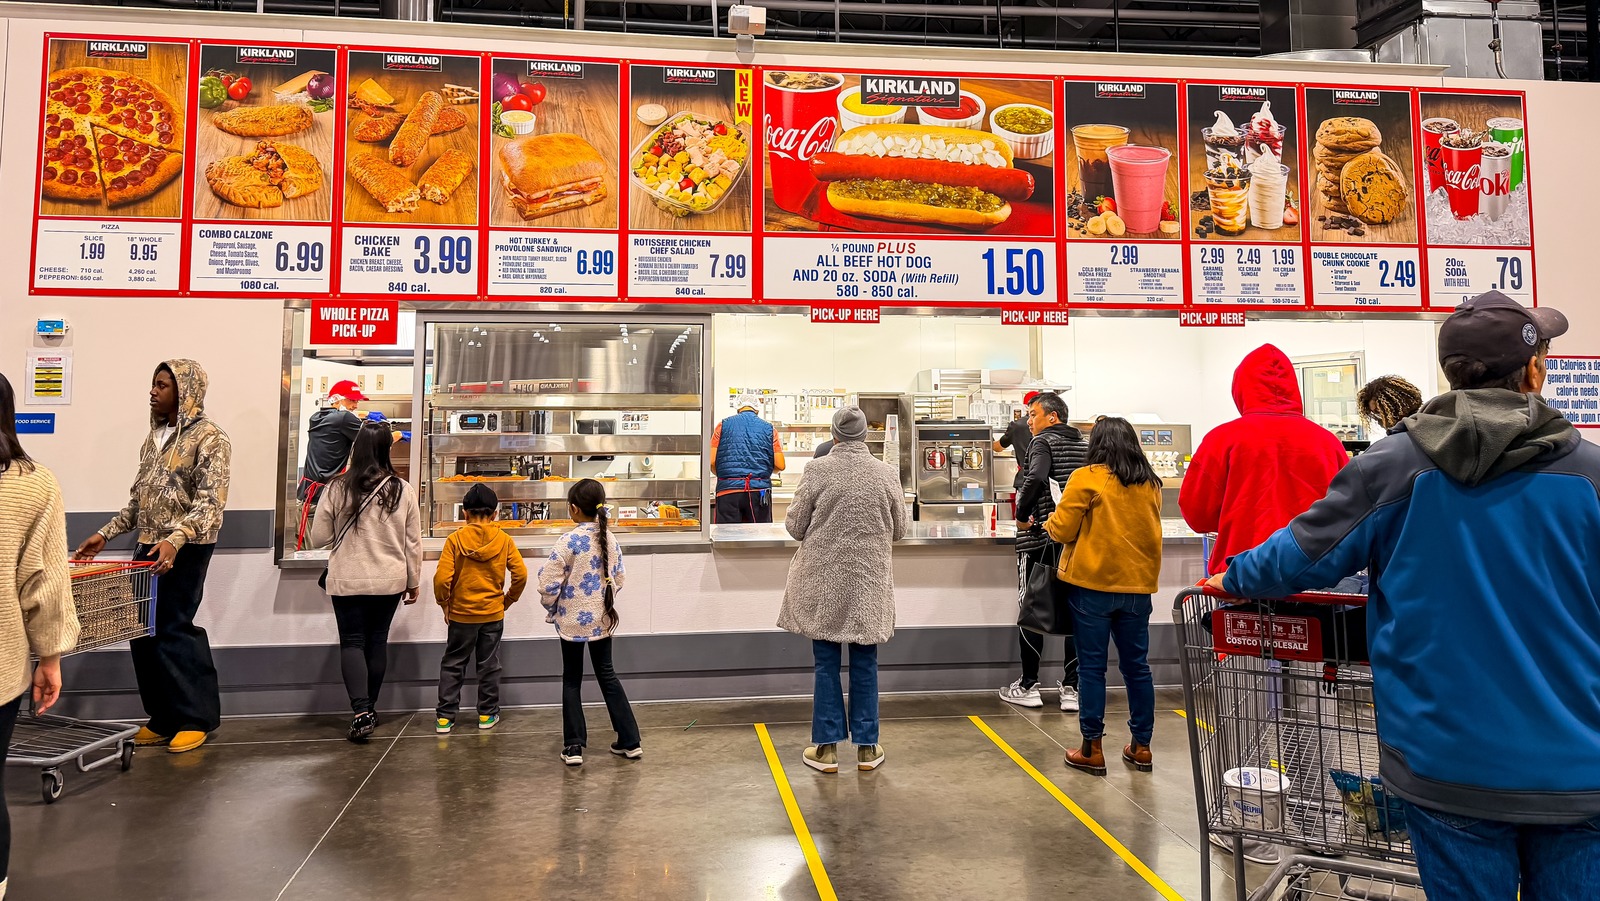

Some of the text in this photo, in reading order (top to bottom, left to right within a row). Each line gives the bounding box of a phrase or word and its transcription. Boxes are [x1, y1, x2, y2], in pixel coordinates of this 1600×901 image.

[90, 42, 146, 53] KIRKLAND
[240, 48, 294, 59] KIRKLAND
[387, 55, 439, 65] KIRKLAND
[531, 62, 581, 72] KIRKLAND
[666, 69, 715, 78] KIRKLAND
[866, 78, 955, 94] KIRKLAND
[1098, 84, 1143, 93] KIRKLAND
[1221, 87, 1265, 96] KIRKLAND
[738, 73, 752, 116] NEW
[867, 93, 955, 105] Signature
[1335, 91, 1378, 99] KIRKLAND
[199, 230, 273, 239] COMBO CALZONE
[355, 235, 400, 246] CHICKEN
[679, 239, 711, 247] CHICKEN
[80, 243, 105, 259] 1.99
[130, 244, 157, 261] 9.95
[363, 247, 391, 256] BAKE
[671, 247, 695, 255] SALAD
[842, 244, 874, 253] POUND
[877, 242, 916, 254] PLUS
[276, 241, 324, 272] 6.99
[414, 236, 472, 274] 3.99
[1111, 245, 1138, 265] 2.99
[1201, 248, 1225, 264] 2.99
[1237, 248, 1261, 265] 2.49
[1272, 249, 1294, 265] 1.99
[577, 250, 614, 275] 6.99
[710, 254, 746, 278] 7.99
[817, 255, 931, 268] ALL BEEF HOT DOG
[1446, 258, 1456, 266] 20
[982, 248, 1045, 295] 1.50
[1379, 260, 1415, 287] 2.49
[1445, 268, 1467, 276] SODA
[1492, 257, 1522, 289] .79
[793, 269, 959, 286] AND 20 oz. SODA (With Refill)
[1444, 278, 1470, 287] WITH REFILL
[240, 281, 279, 290] 1080 cal.
[388, 282, 430, 292] 840 cal.
[676, 287, 690, 295] 840
[836, 285, 918, 298] 580 850 cal.
[320, 308, 389, 321] WHOLE PIZZA
[813, 309, 878, 322] PICK-UP HERE
[1003, 310, 1067, 324] PICK-UP HERE
[1182, 312, 1244, 326] PICK-UP HERE
[332, 325, 376, 338] PICK-UP
[1560, 360, 1586, 370] Calories
[1548, 373, 1599, 384] general nutrition
[1556, 386, 1598, 396] calorie needs
[1571, 399, 1597, 409] nutrition
[1581, 414, 1595, 424] upon
[1226, 637, 1257, 646] COSTCO
